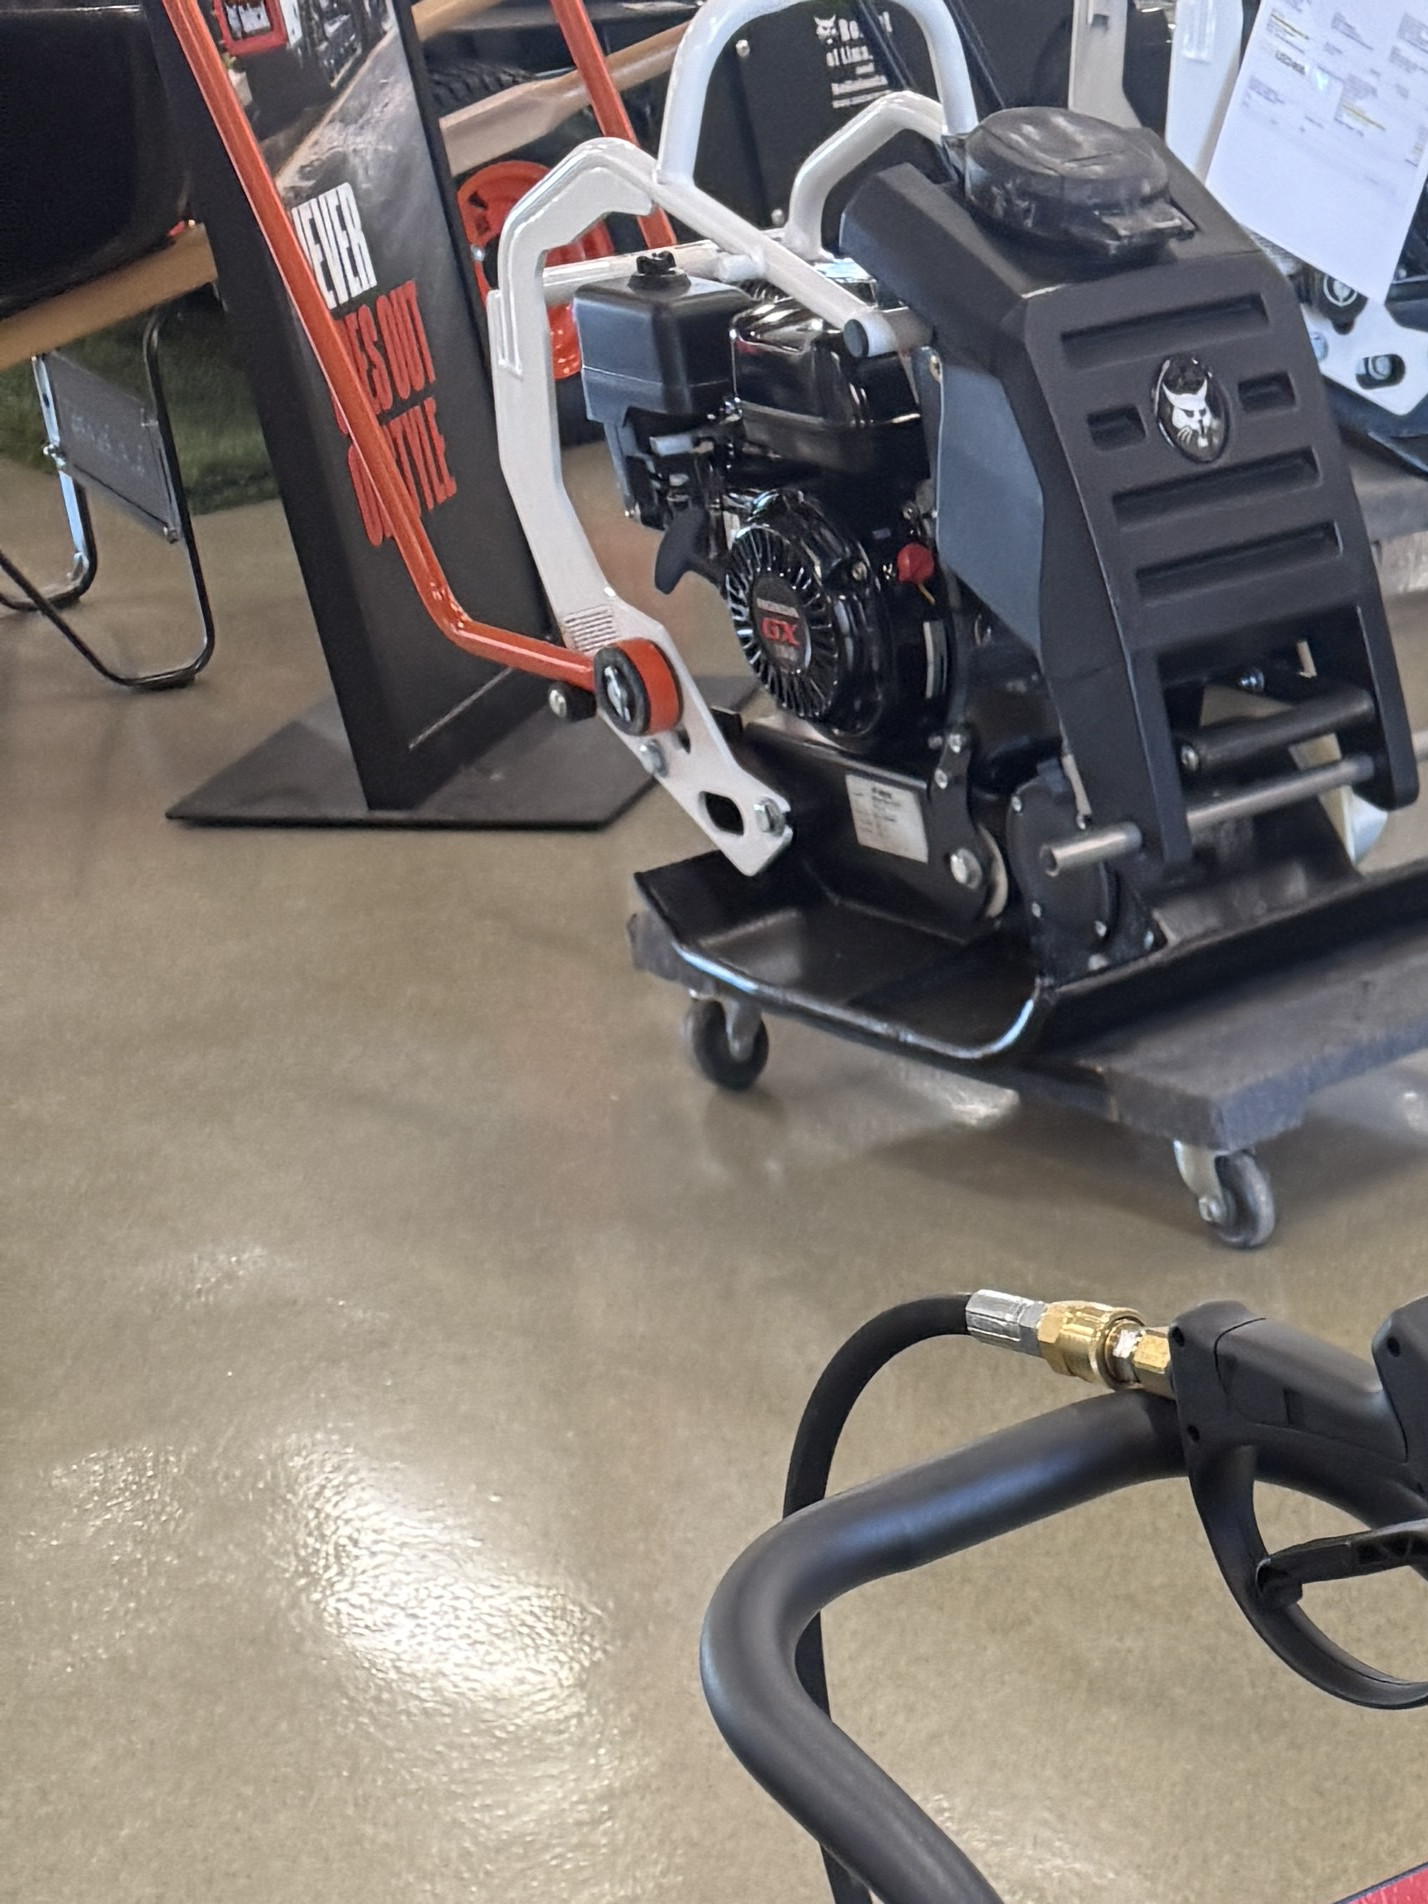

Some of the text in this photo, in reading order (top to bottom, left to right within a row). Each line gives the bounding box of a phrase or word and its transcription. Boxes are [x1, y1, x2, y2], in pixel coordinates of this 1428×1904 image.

[376, 280, 436, 400] OUT
[382, 397, 457, 520] TYLE
[760, 616, 800, 648] GX
